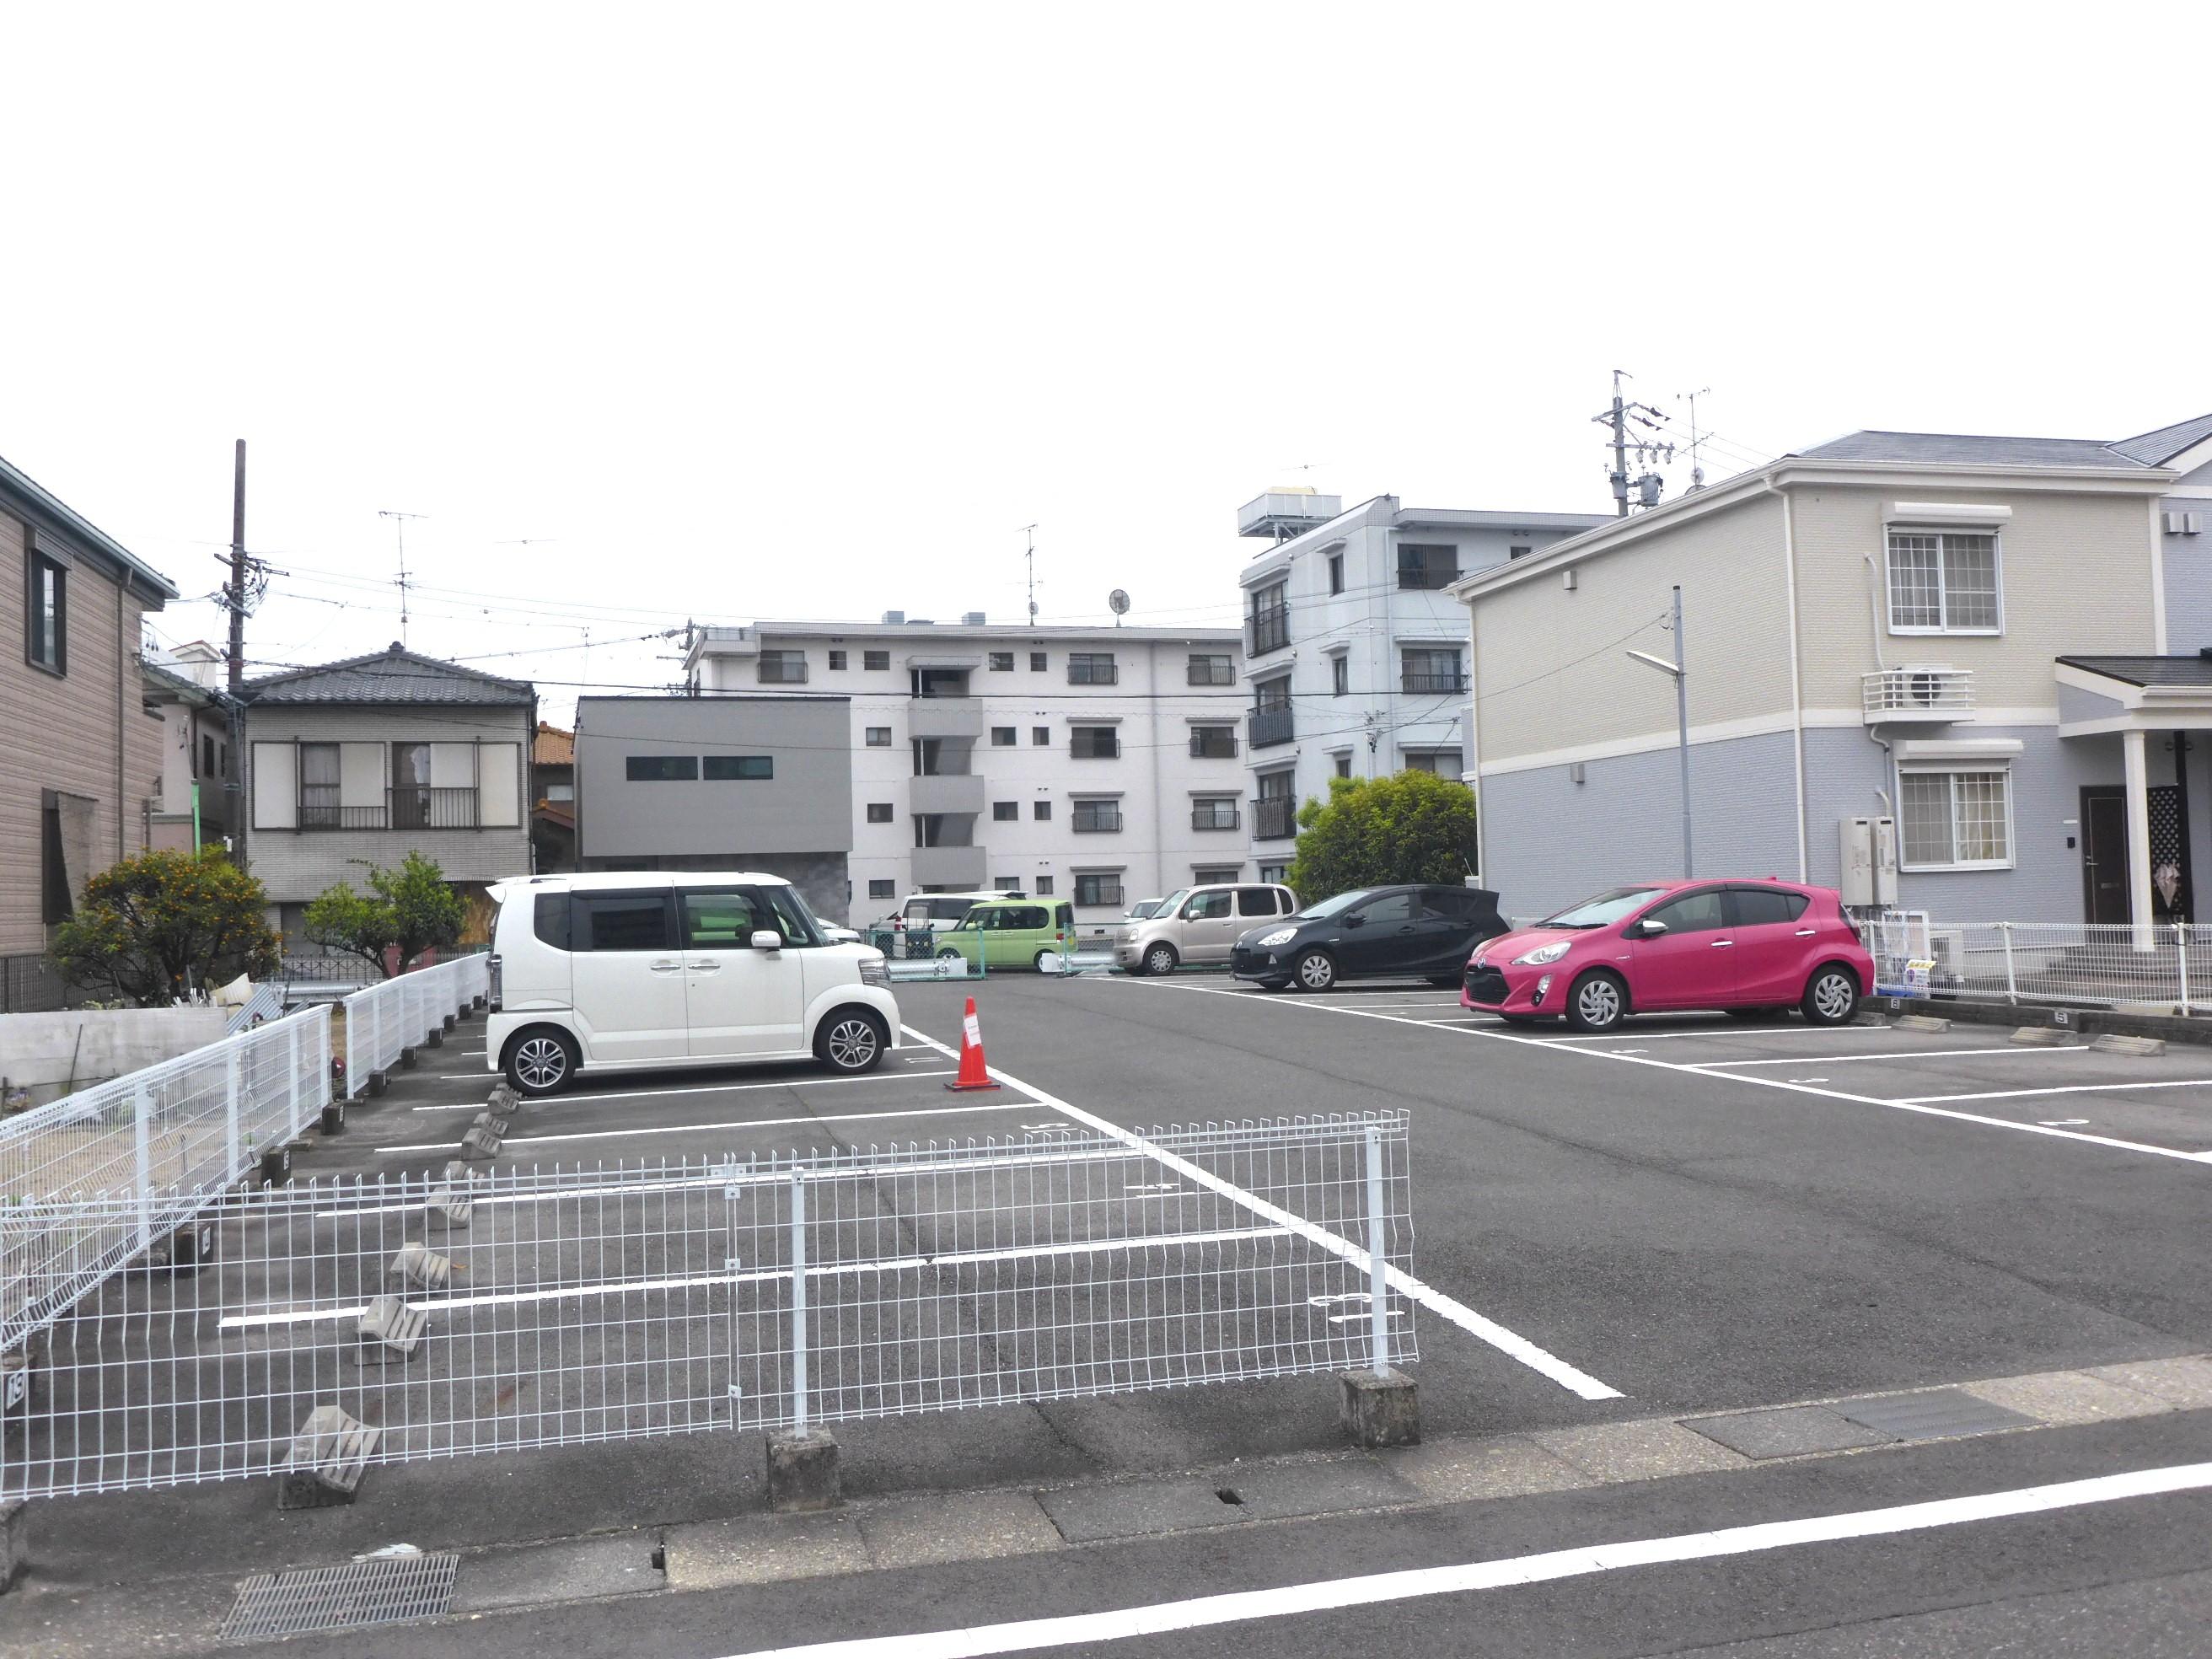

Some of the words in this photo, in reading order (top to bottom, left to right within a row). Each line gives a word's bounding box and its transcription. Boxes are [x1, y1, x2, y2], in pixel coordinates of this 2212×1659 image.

[2058, 1012, 2064, 1023] 5
[1020, 1123, 1078, 1134] 15
[1306, 1292, 1405, 1323] 13
